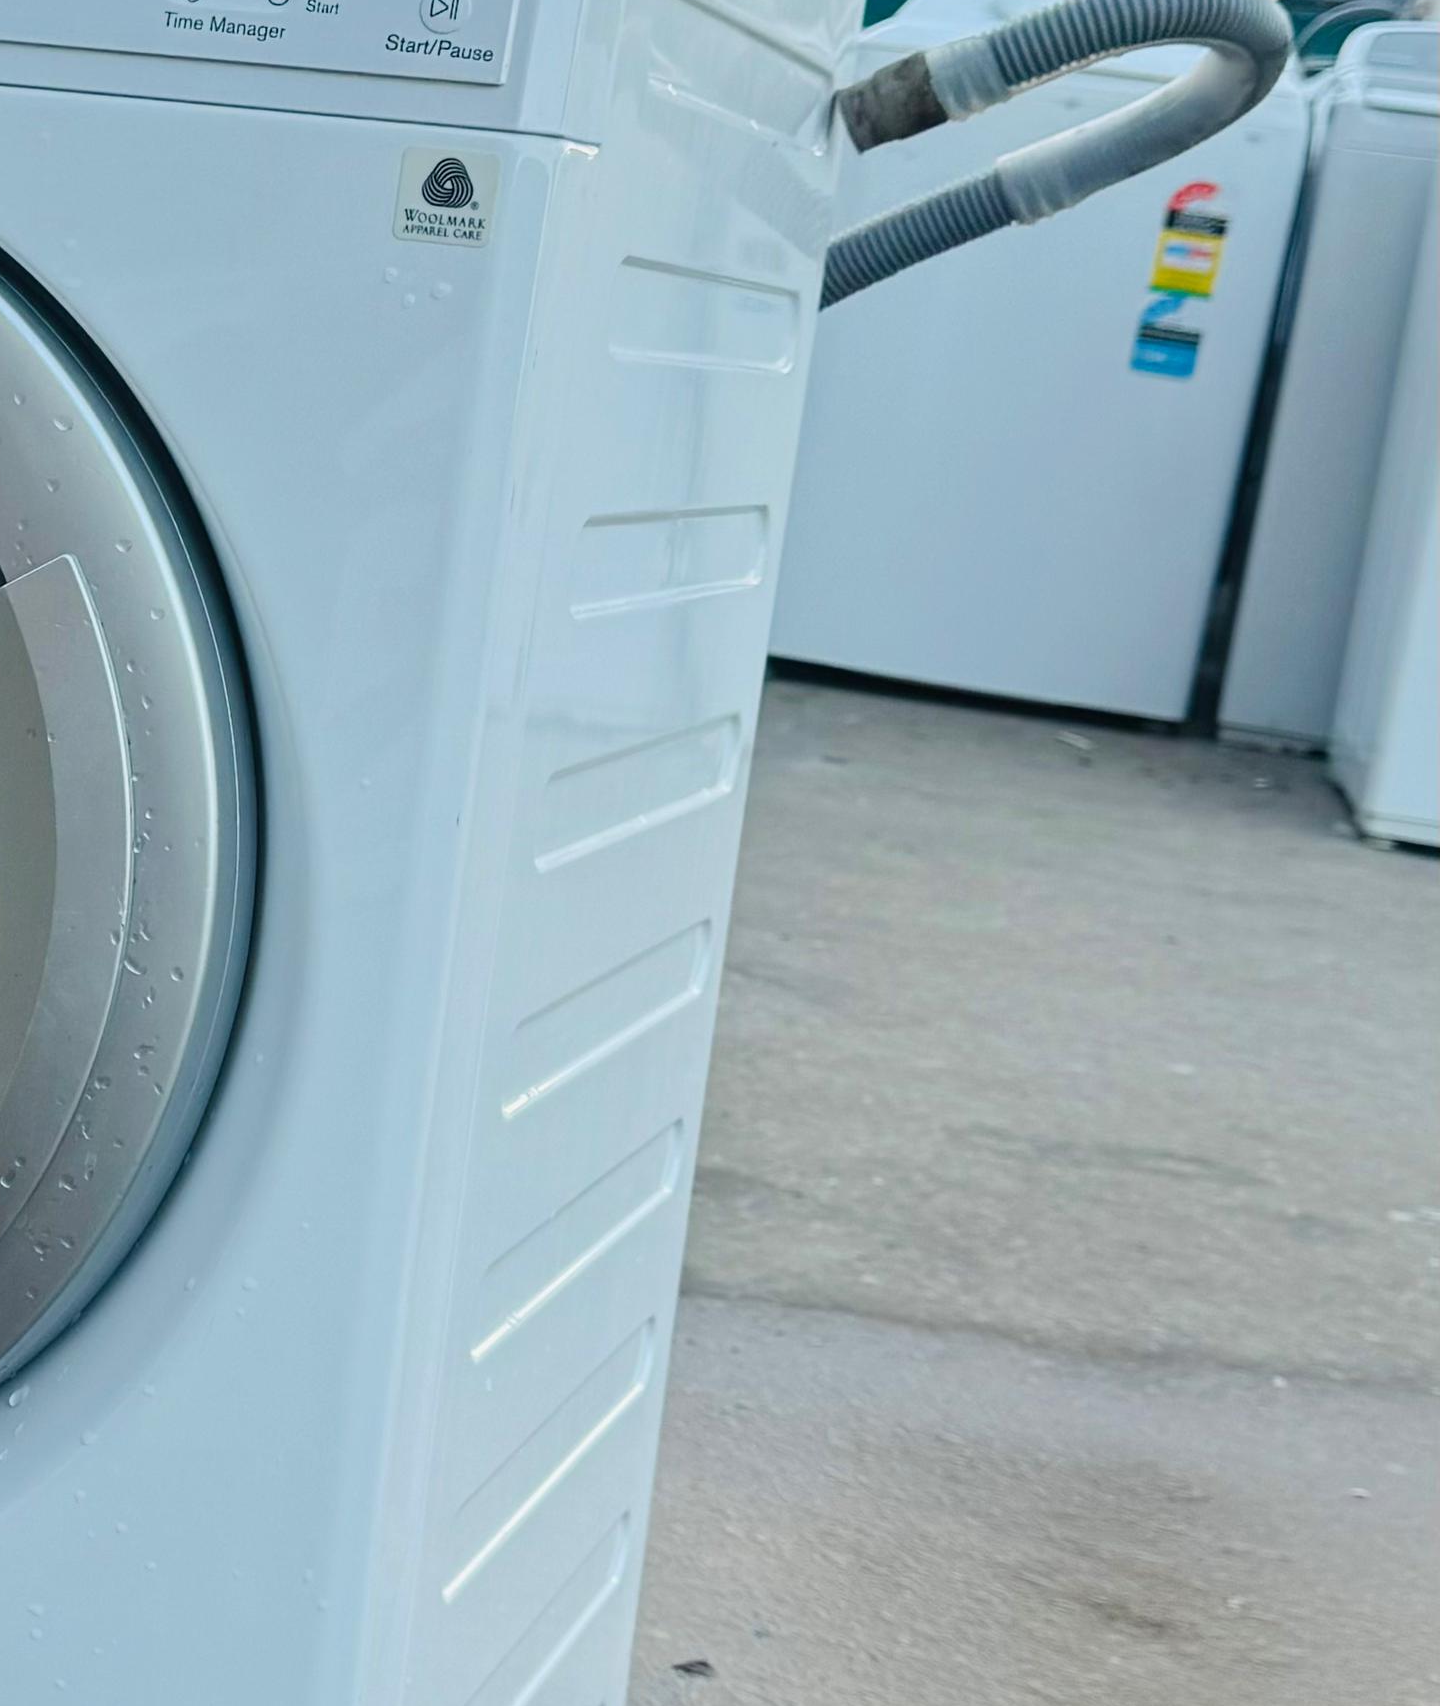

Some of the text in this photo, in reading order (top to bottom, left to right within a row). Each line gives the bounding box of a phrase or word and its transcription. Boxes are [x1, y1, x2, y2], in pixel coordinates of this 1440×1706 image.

[305, 0, 340, 15] Start
[164, 11, 286, 41] Time Manager
[385, 33, 494, 62] Start/Pause
[404, 208, 487, 230] WOOLMARK
[402, 224, 483, 241] APPAREL CARE
